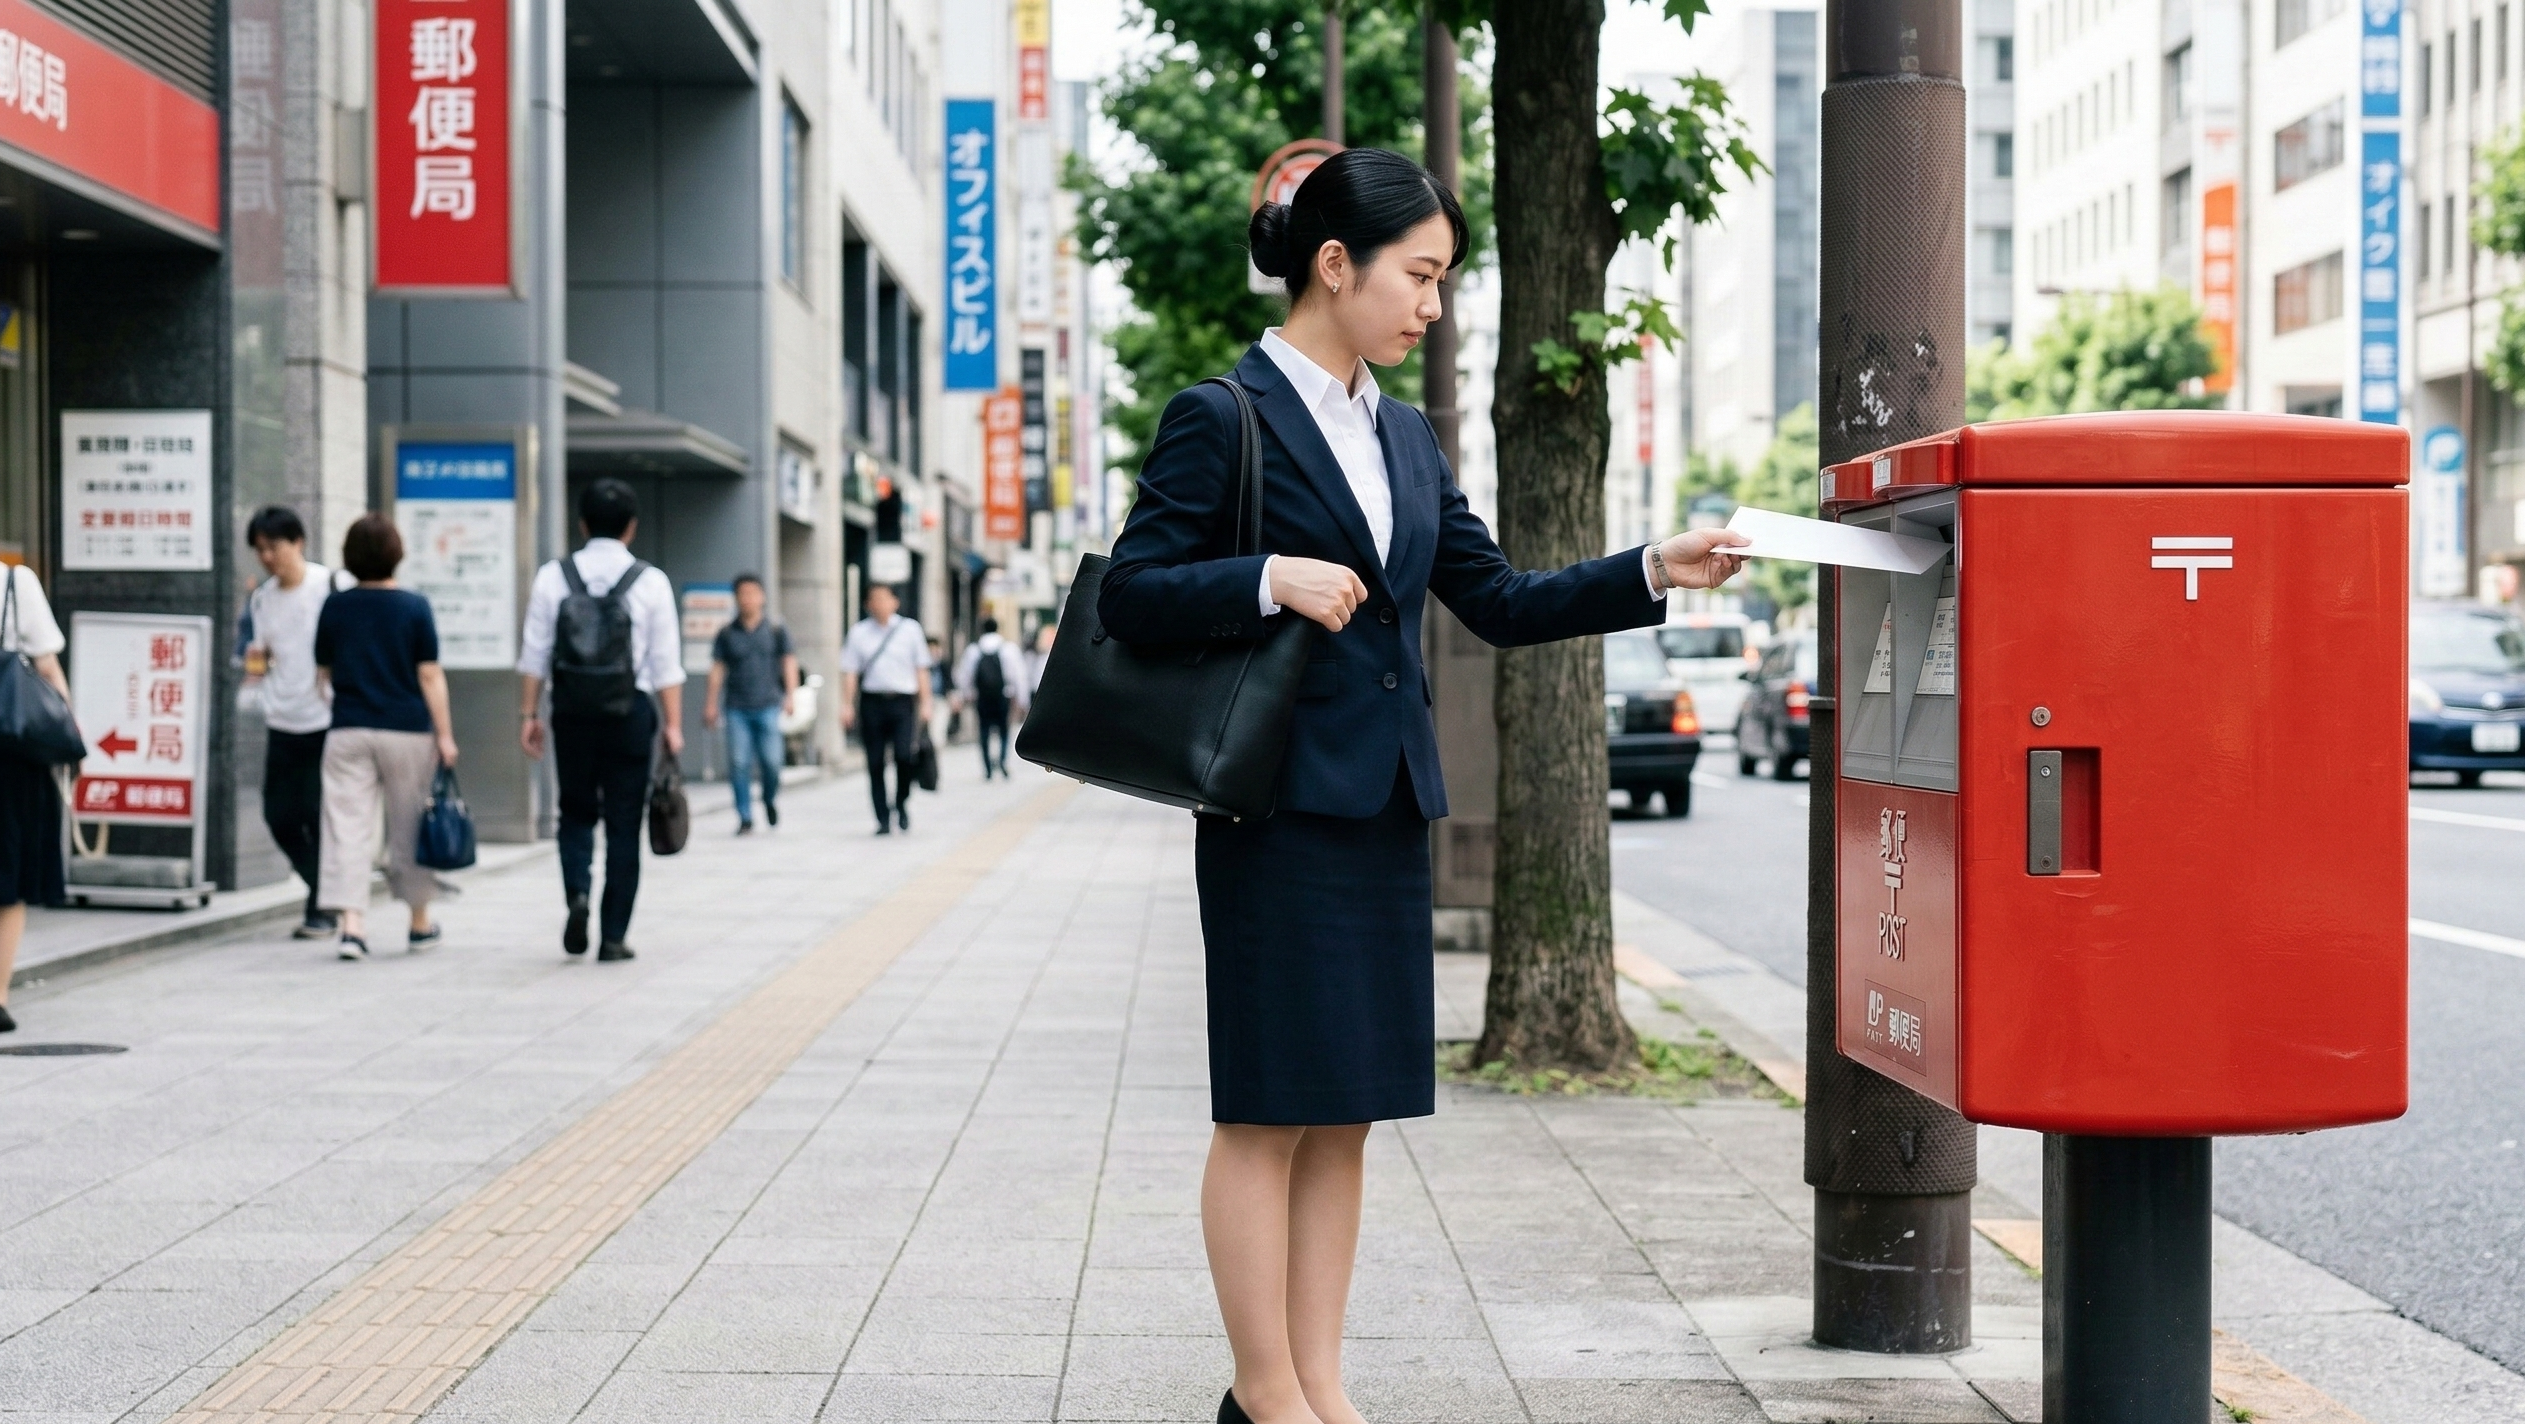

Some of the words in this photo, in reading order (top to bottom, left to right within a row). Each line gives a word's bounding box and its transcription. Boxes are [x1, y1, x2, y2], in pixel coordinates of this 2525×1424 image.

[409, 16, 478, 221] 郵便局
[950, 127, 991, 355] オフィスビル
[148, 633, 187, 765] 郵便局
[1879, 807, 1907, 864] 郵便
[1878, 911, 1908, 963] POST
